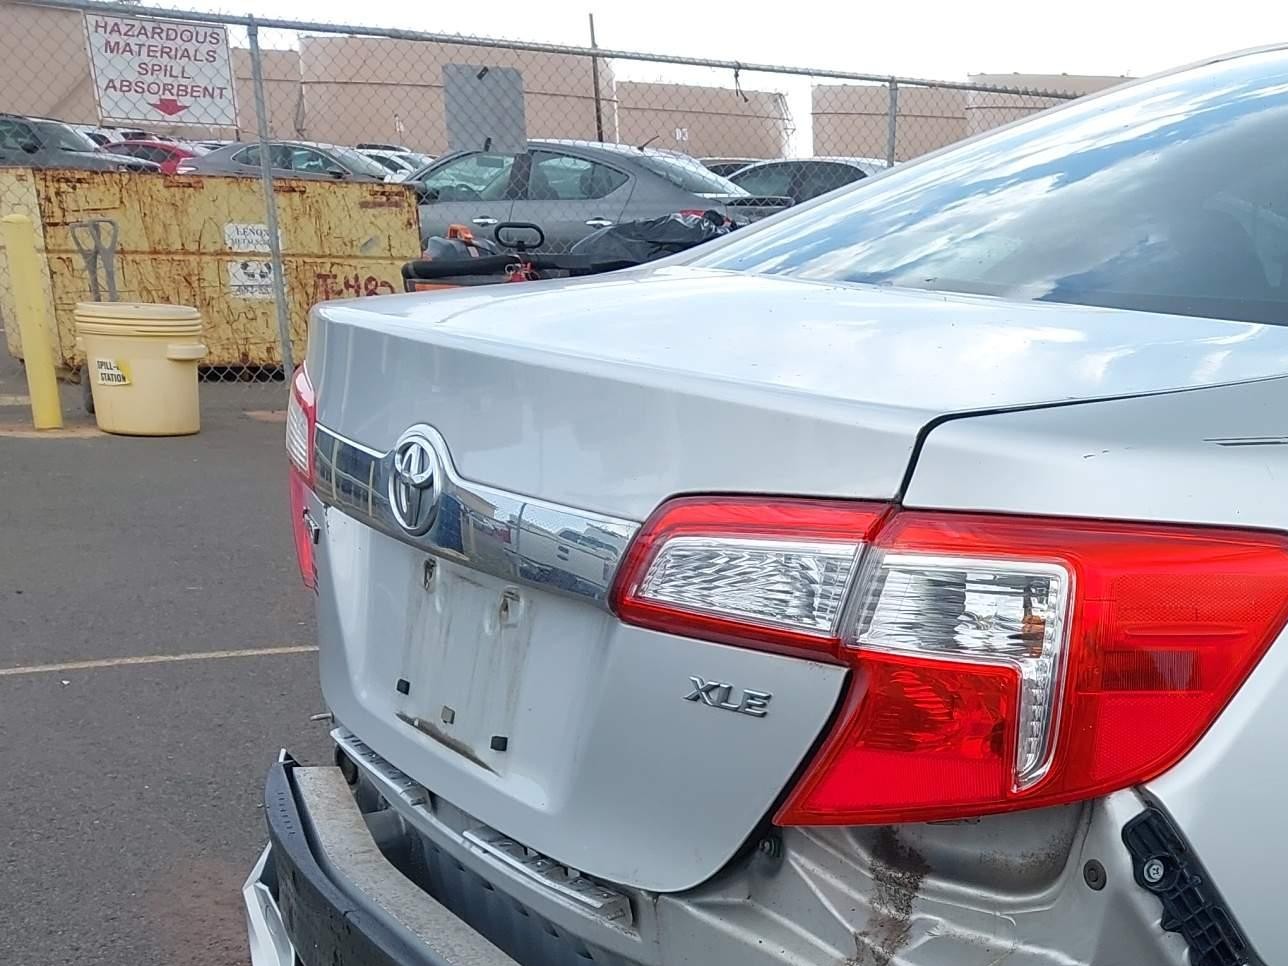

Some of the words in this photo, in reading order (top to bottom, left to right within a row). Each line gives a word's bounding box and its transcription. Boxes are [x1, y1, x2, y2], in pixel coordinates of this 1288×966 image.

[95, 20, 220, 45] HAZARDOUS
[104, 40, 217, 63] MATERIALS
[137, 62, 192, 80] SPILL
[104, 78, 228, 100] ABSORBENT
[100, 372, 127, 383] STATION
[682, 676, 773, 718] XLE
